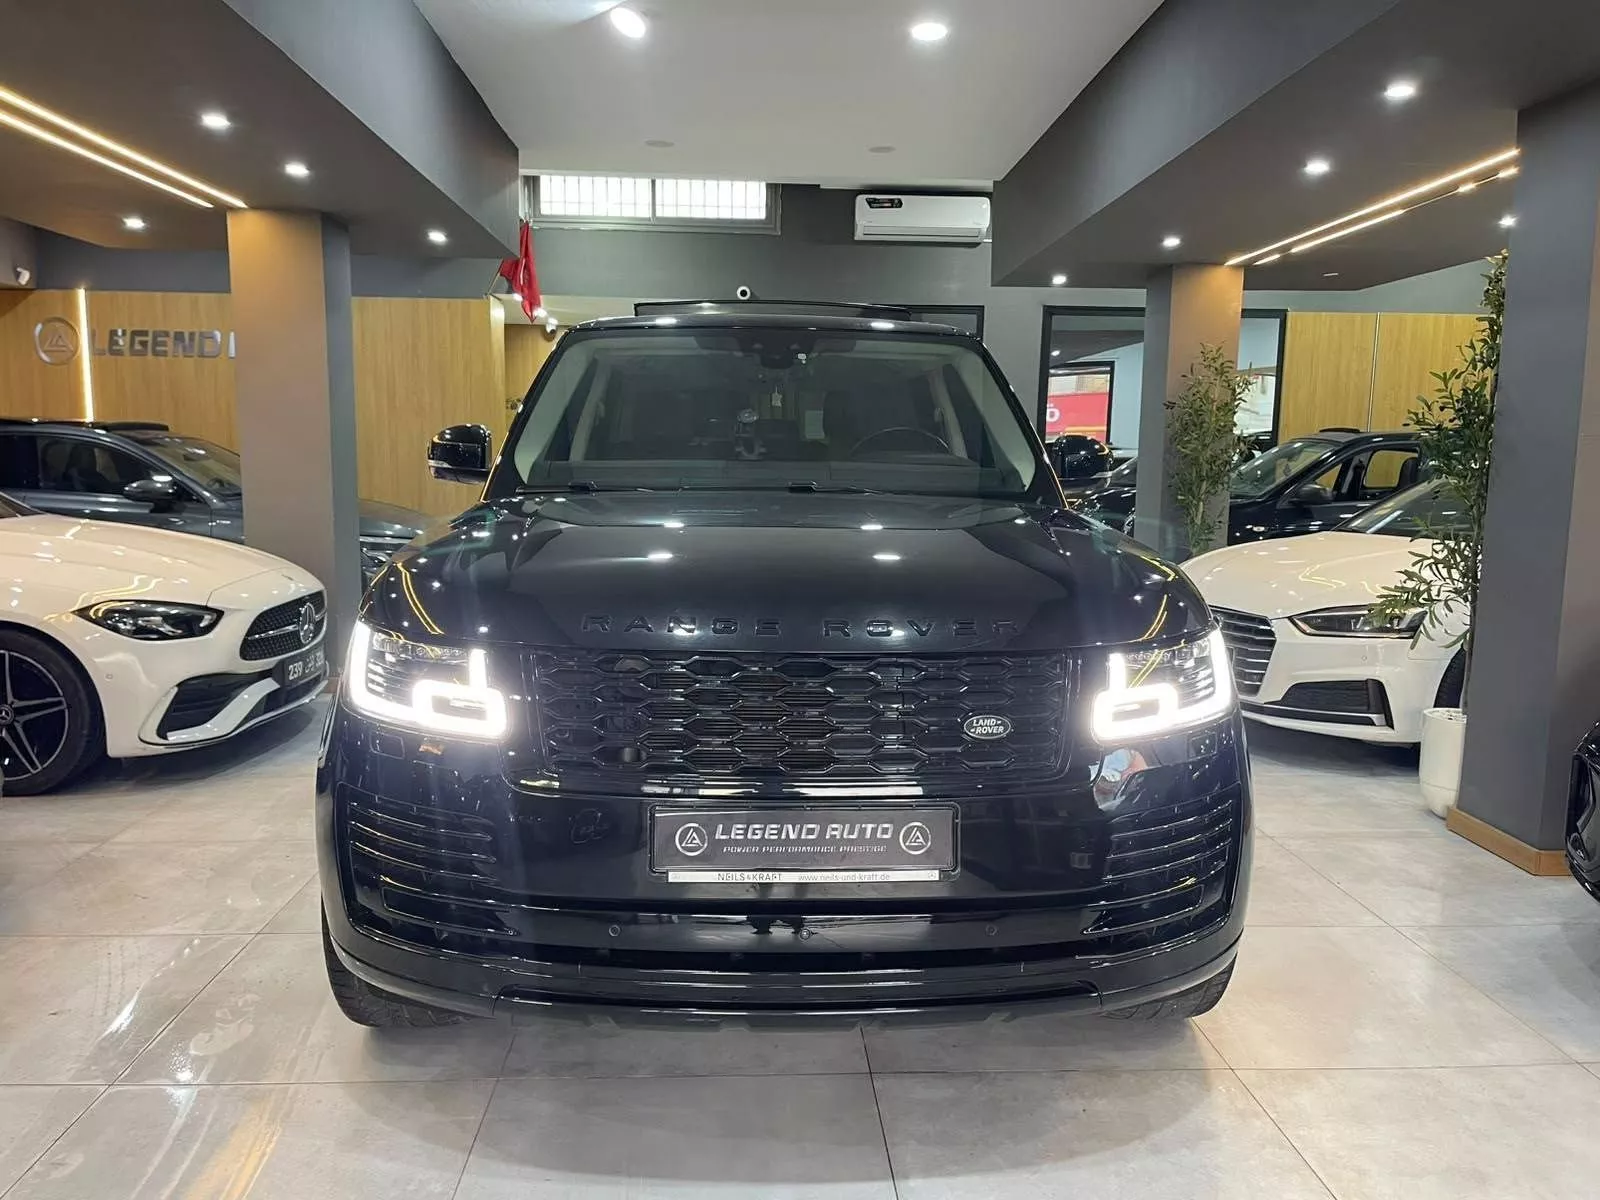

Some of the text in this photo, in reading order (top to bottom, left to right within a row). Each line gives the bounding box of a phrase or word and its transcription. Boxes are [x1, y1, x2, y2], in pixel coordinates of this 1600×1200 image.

[91, 328, 222, 358] LEGEND
[582, 614, 1020, 638] RANGE ROVER
[715, 823, 894, 840] LEGEND AUTO
